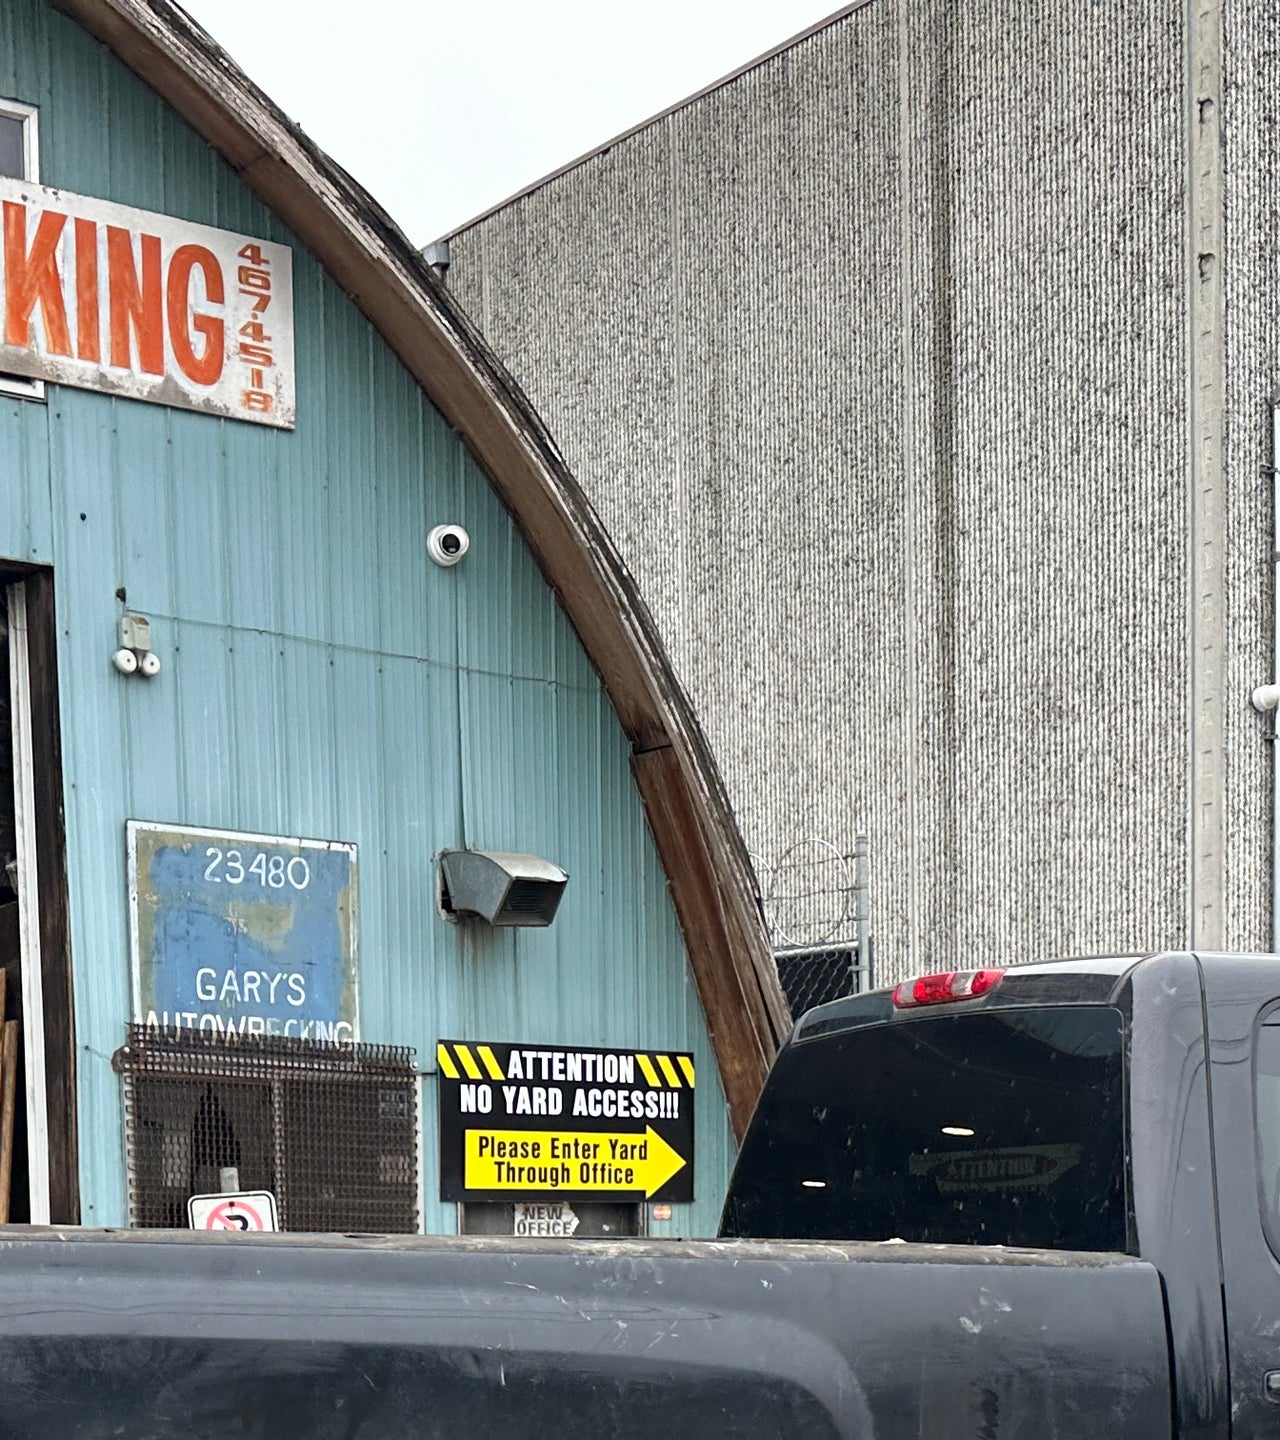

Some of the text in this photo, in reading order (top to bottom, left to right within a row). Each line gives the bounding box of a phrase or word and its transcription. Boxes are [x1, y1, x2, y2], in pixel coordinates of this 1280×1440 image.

[204, 847, 309, 889] 23480
[195, 967, 306, 1007] GARY'S
[508, 1050, 635, 1084] ATTENTION
[460, 1083, 679, 1120] NO YARD ACCESS!!!
[478, 1137, 649, 1162] Please Enter Yard
[494, 1161, 634, 1186] Through Office
[524, 1205, 563, 1221] NEW
[517, 1220, 571, 1236] OFFICE
